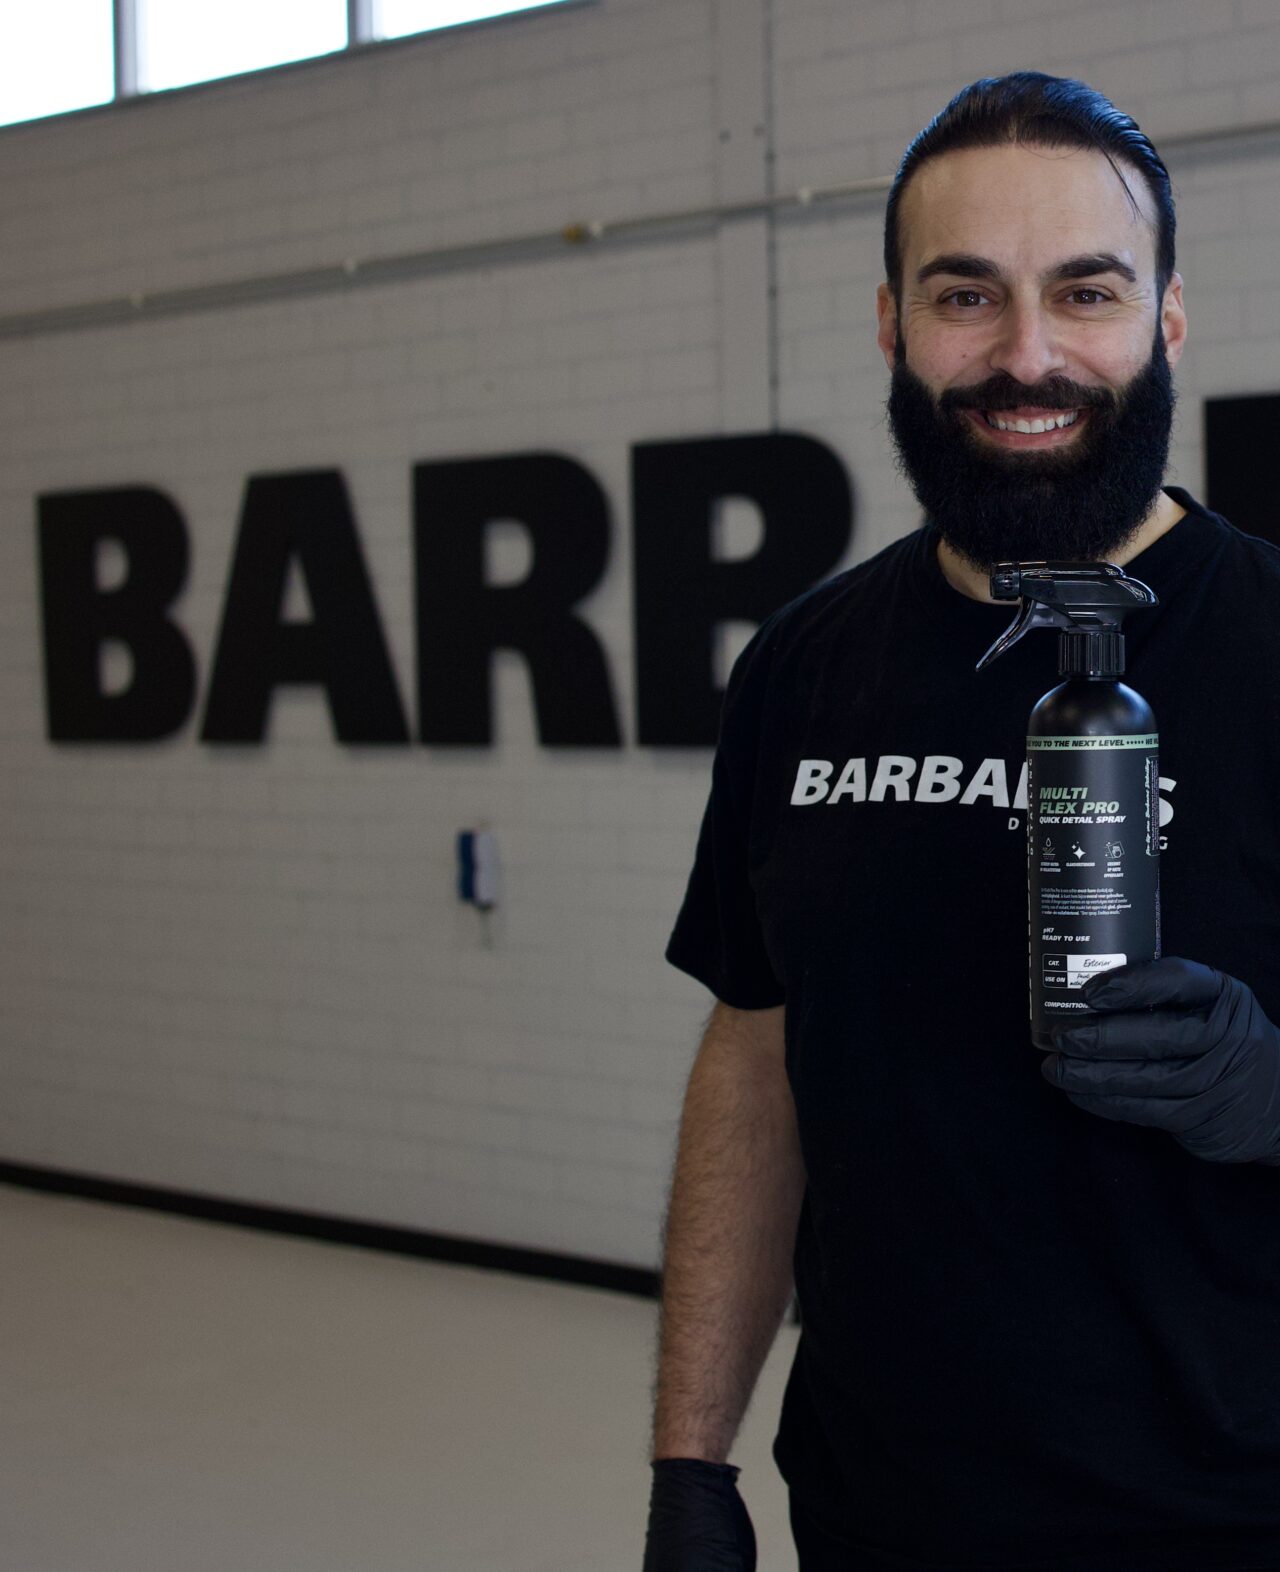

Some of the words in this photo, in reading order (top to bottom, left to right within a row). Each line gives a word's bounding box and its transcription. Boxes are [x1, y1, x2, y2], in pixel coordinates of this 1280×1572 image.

[1043, 740, 1052, 748] TO
[1098, 739, 1125, 747] LEVEL
[790, 755, 1177, 828] BARBAS
[1040, 787, 1088, 800] MULTI
[1040, 802, 1078, 814] FLEX
[1081, 801, 1120, 814] PRO
[1039, 816, 1061, 825] QUICK
[1062, 816, 1094, 824] DETAIL
[1095, 815, 1126, 824] SPRAY
